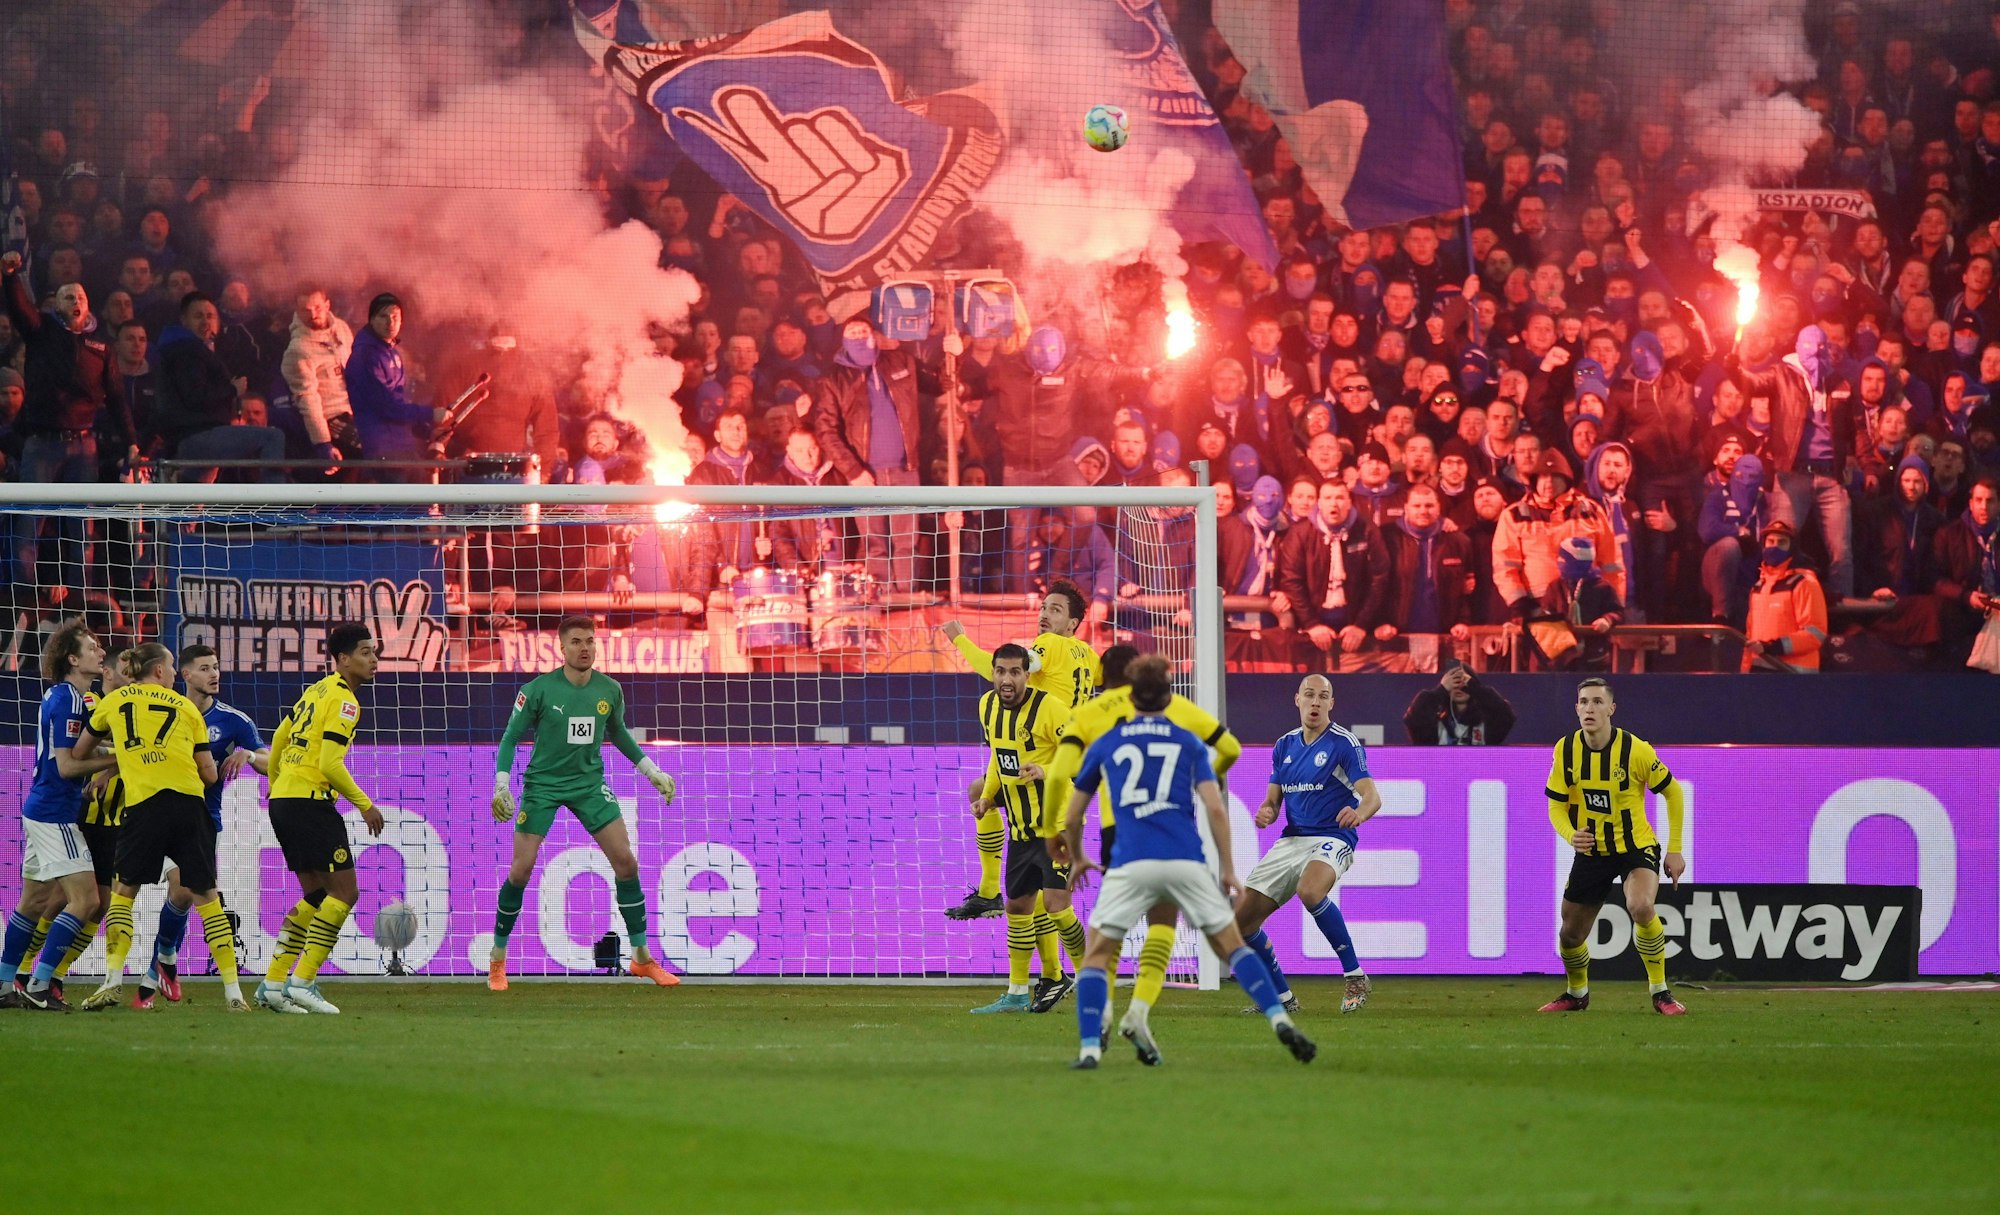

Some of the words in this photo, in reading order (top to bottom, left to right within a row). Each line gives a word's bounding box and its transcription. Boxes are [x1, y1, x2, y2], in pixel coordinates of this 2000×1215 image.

[1758, 193, 1864, 213] KSTADION
[183, 582, 238, 619] WIR
[253, 585, 366, 622] WERDEN
[183, 624, 338, 672] IEGE
[500, 631, 703, 673] FUSSALLCLUB
[119, 702, 180, 752] 17
[571, 723, 592, 737] 1&1
[997, 754, 1019, 770] 1&1
[1112, 742, 1182, 807] 27
[1281, 781, 1324, 794] MeinAuto.de
[1585, 793, 1609, 808] 1&1
